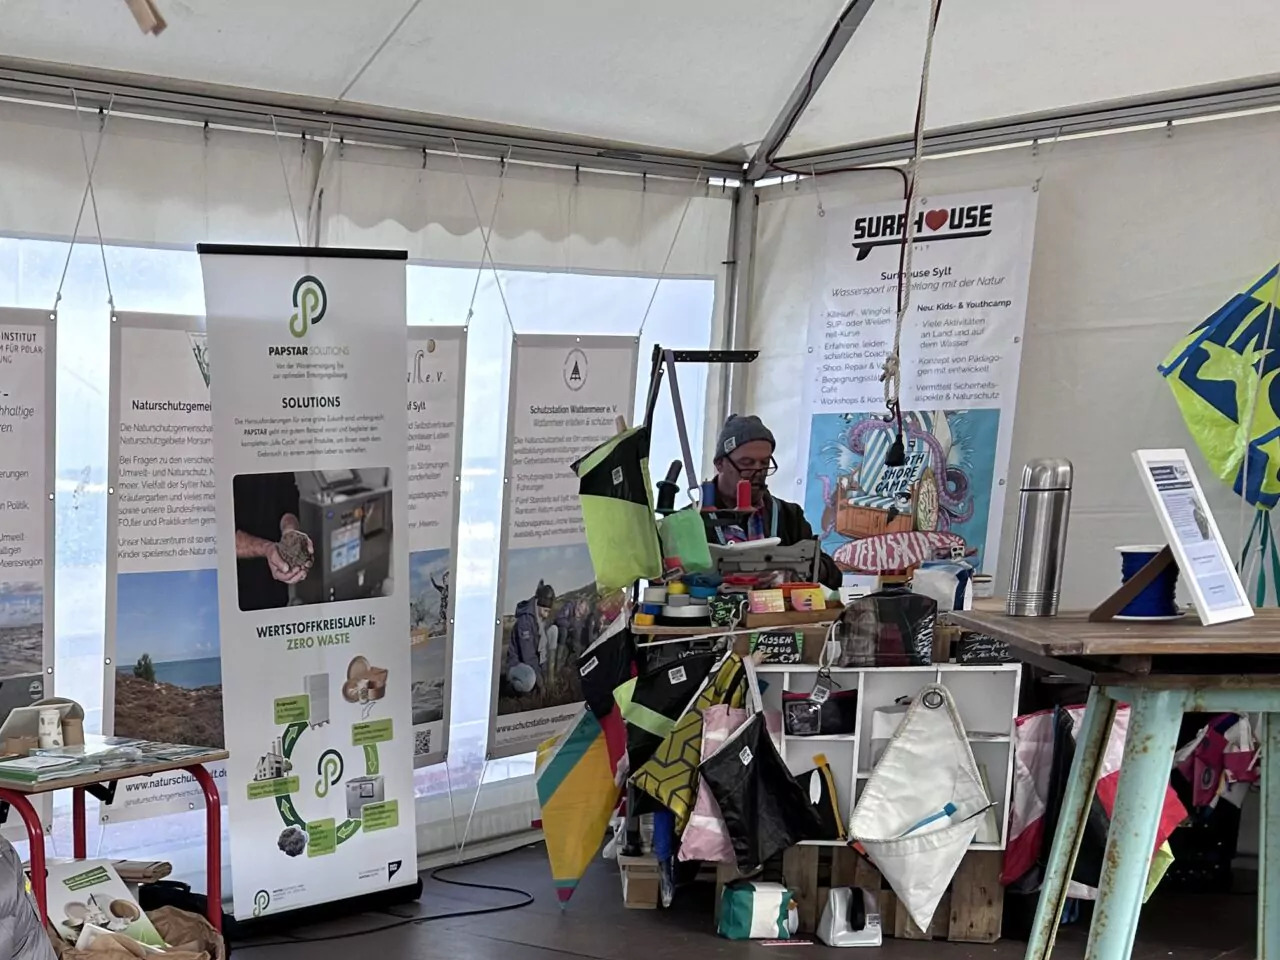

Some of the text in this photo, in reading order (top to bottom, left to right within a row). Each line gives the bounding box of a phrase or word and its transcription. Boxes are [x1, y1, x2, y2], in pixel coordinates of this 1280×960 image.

[933, 266, 952, 278] Sylt
[832, 284, 885, 297] Wassersport
[887, 282, 898, 291] im
[942, 278, 956, 288] mit
[959, 278, 974, 288] der
[976, 276, 1005, 286] Natur
[966, 300, 1012, 308] Youthcamp
[846, 319, 863, 327] oder
[943, 318, 986, 327] Aktivitäten
[933, 330, 952, 338] Land
[920, 340, 969, 348] dem Wasser
[918, 356, 950, 364] Konzept
[917, 368, 933, 376] gen
[953, 392, 1000, 400] Naturschutz
[282, 396, 341, 409] SOLUTIONS
[820, 397, 859, 405] Workshops
[412, 401, 426, 413] Sylt
[529, 404, 605, 414] Schutzstation Wattenmeer
[244, 428, 268, 436] PAPSTAR
[120, 455, 183, 467] Bei Fragen den
[881, 466, 919, 480] SHORE
[167, 480, 179, 489] der
[875, 480, 908, 493] CAMP
[256, 615, 367, 639] WERTSTOFFKREISLAUF
[287, 632, 351, 651] ZERO WASTE
